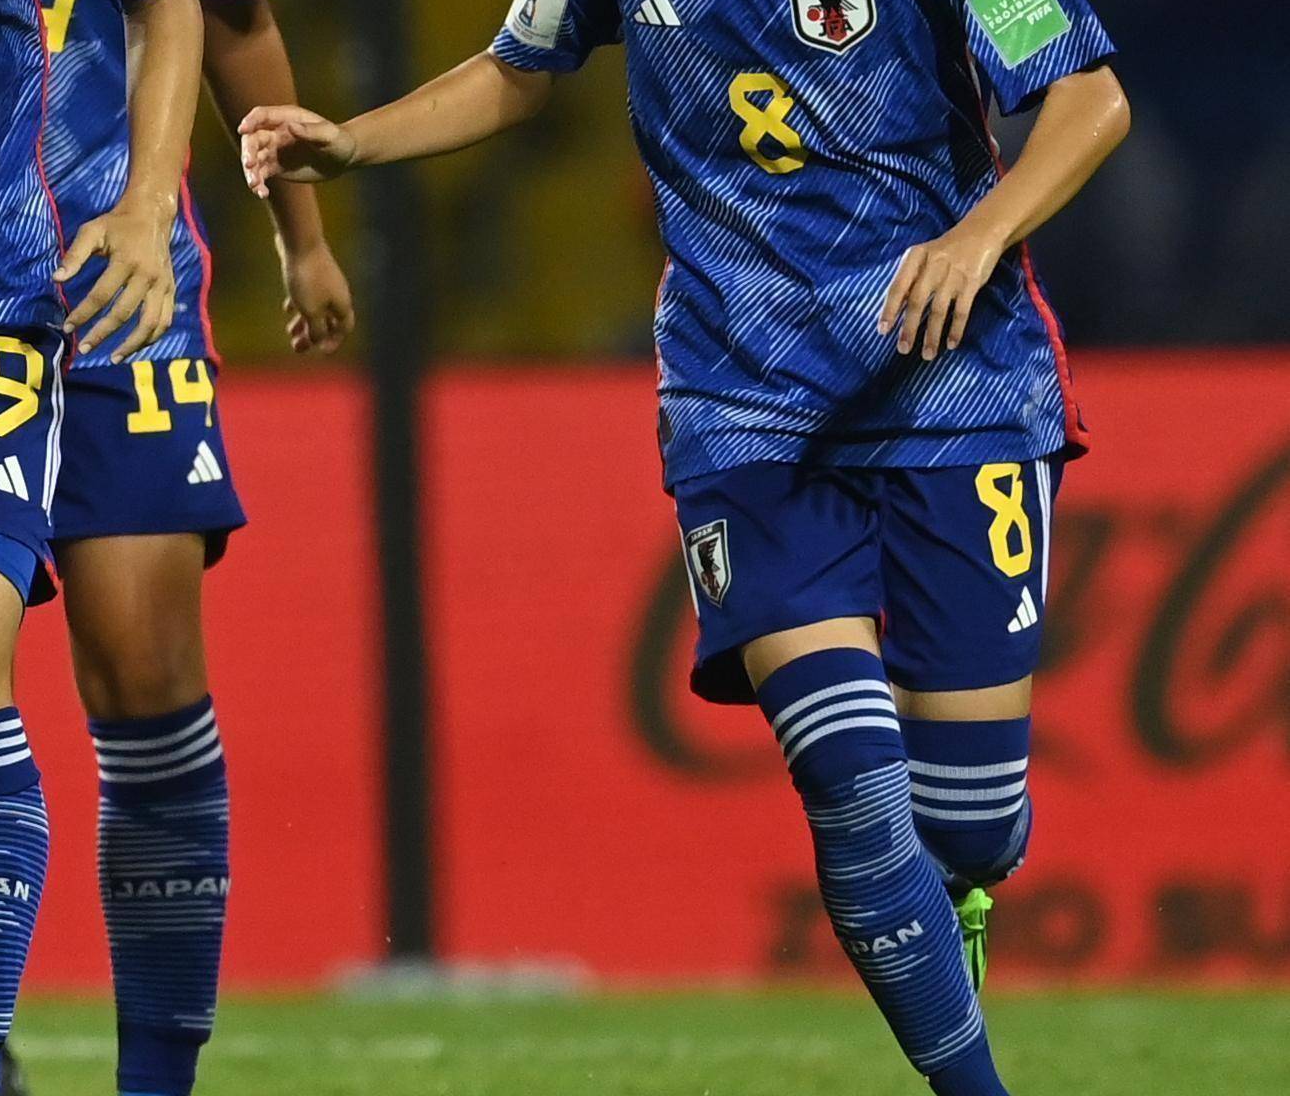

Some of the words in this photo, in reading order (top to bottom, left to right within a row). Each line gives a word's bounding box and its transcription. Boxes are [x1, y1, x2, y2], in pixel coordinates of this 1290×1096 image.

[818, 18, 854, 38] JFA
[1026, 2, 1053, 26] FIFA
[728, 71, 807, 175] 8
[127, 359, 214, 434] 14
[974, 462, 1032, 578] 8
[850, 919, 924, 956] PAN
